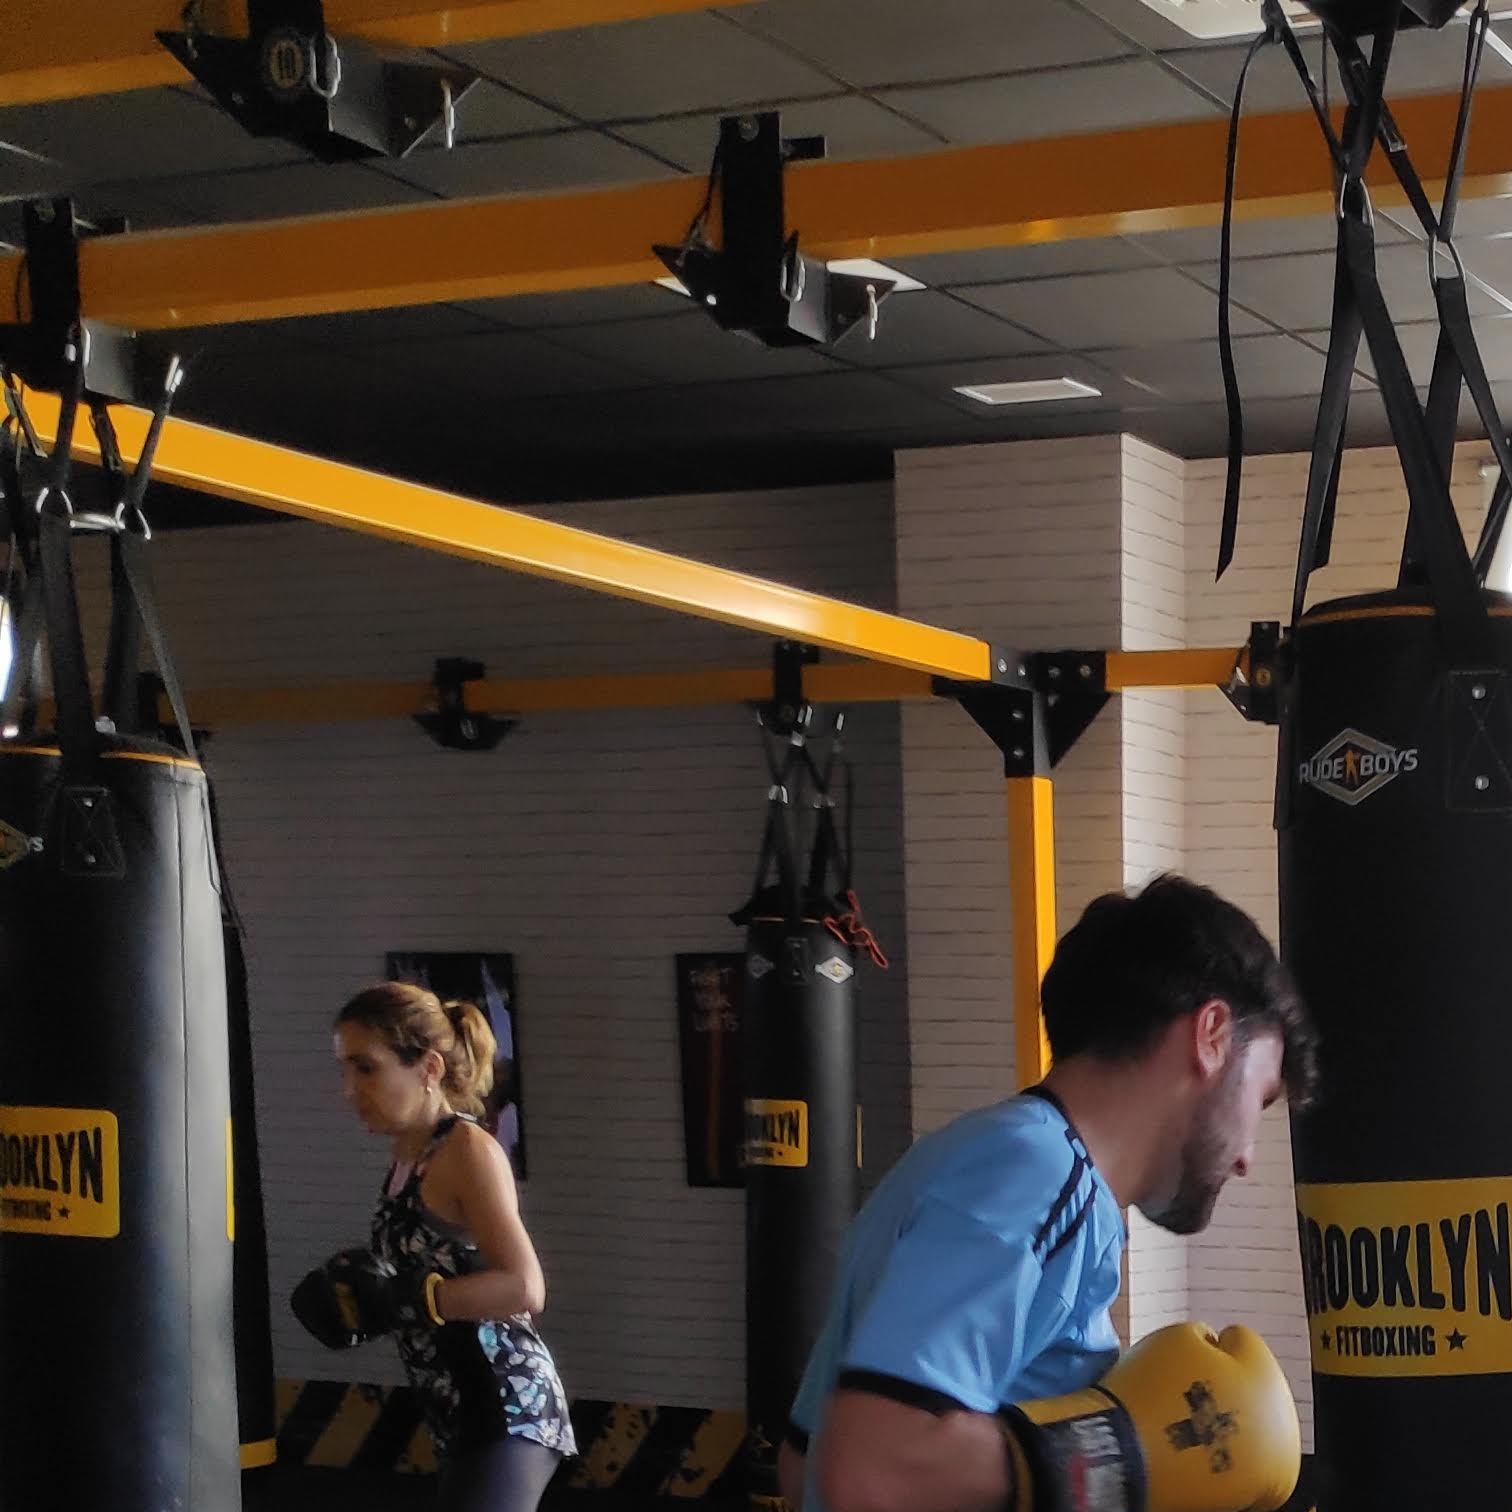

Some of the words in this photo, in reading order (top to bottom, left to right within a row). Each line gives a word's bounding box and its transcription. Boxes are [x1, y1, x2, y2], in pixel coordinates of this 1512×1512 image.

[1299, 756, 1345, 784] RUDE
[1360, 748, 1418, 777] BOYS
[1336, 1326, 1436, 1357] FITBOXING
